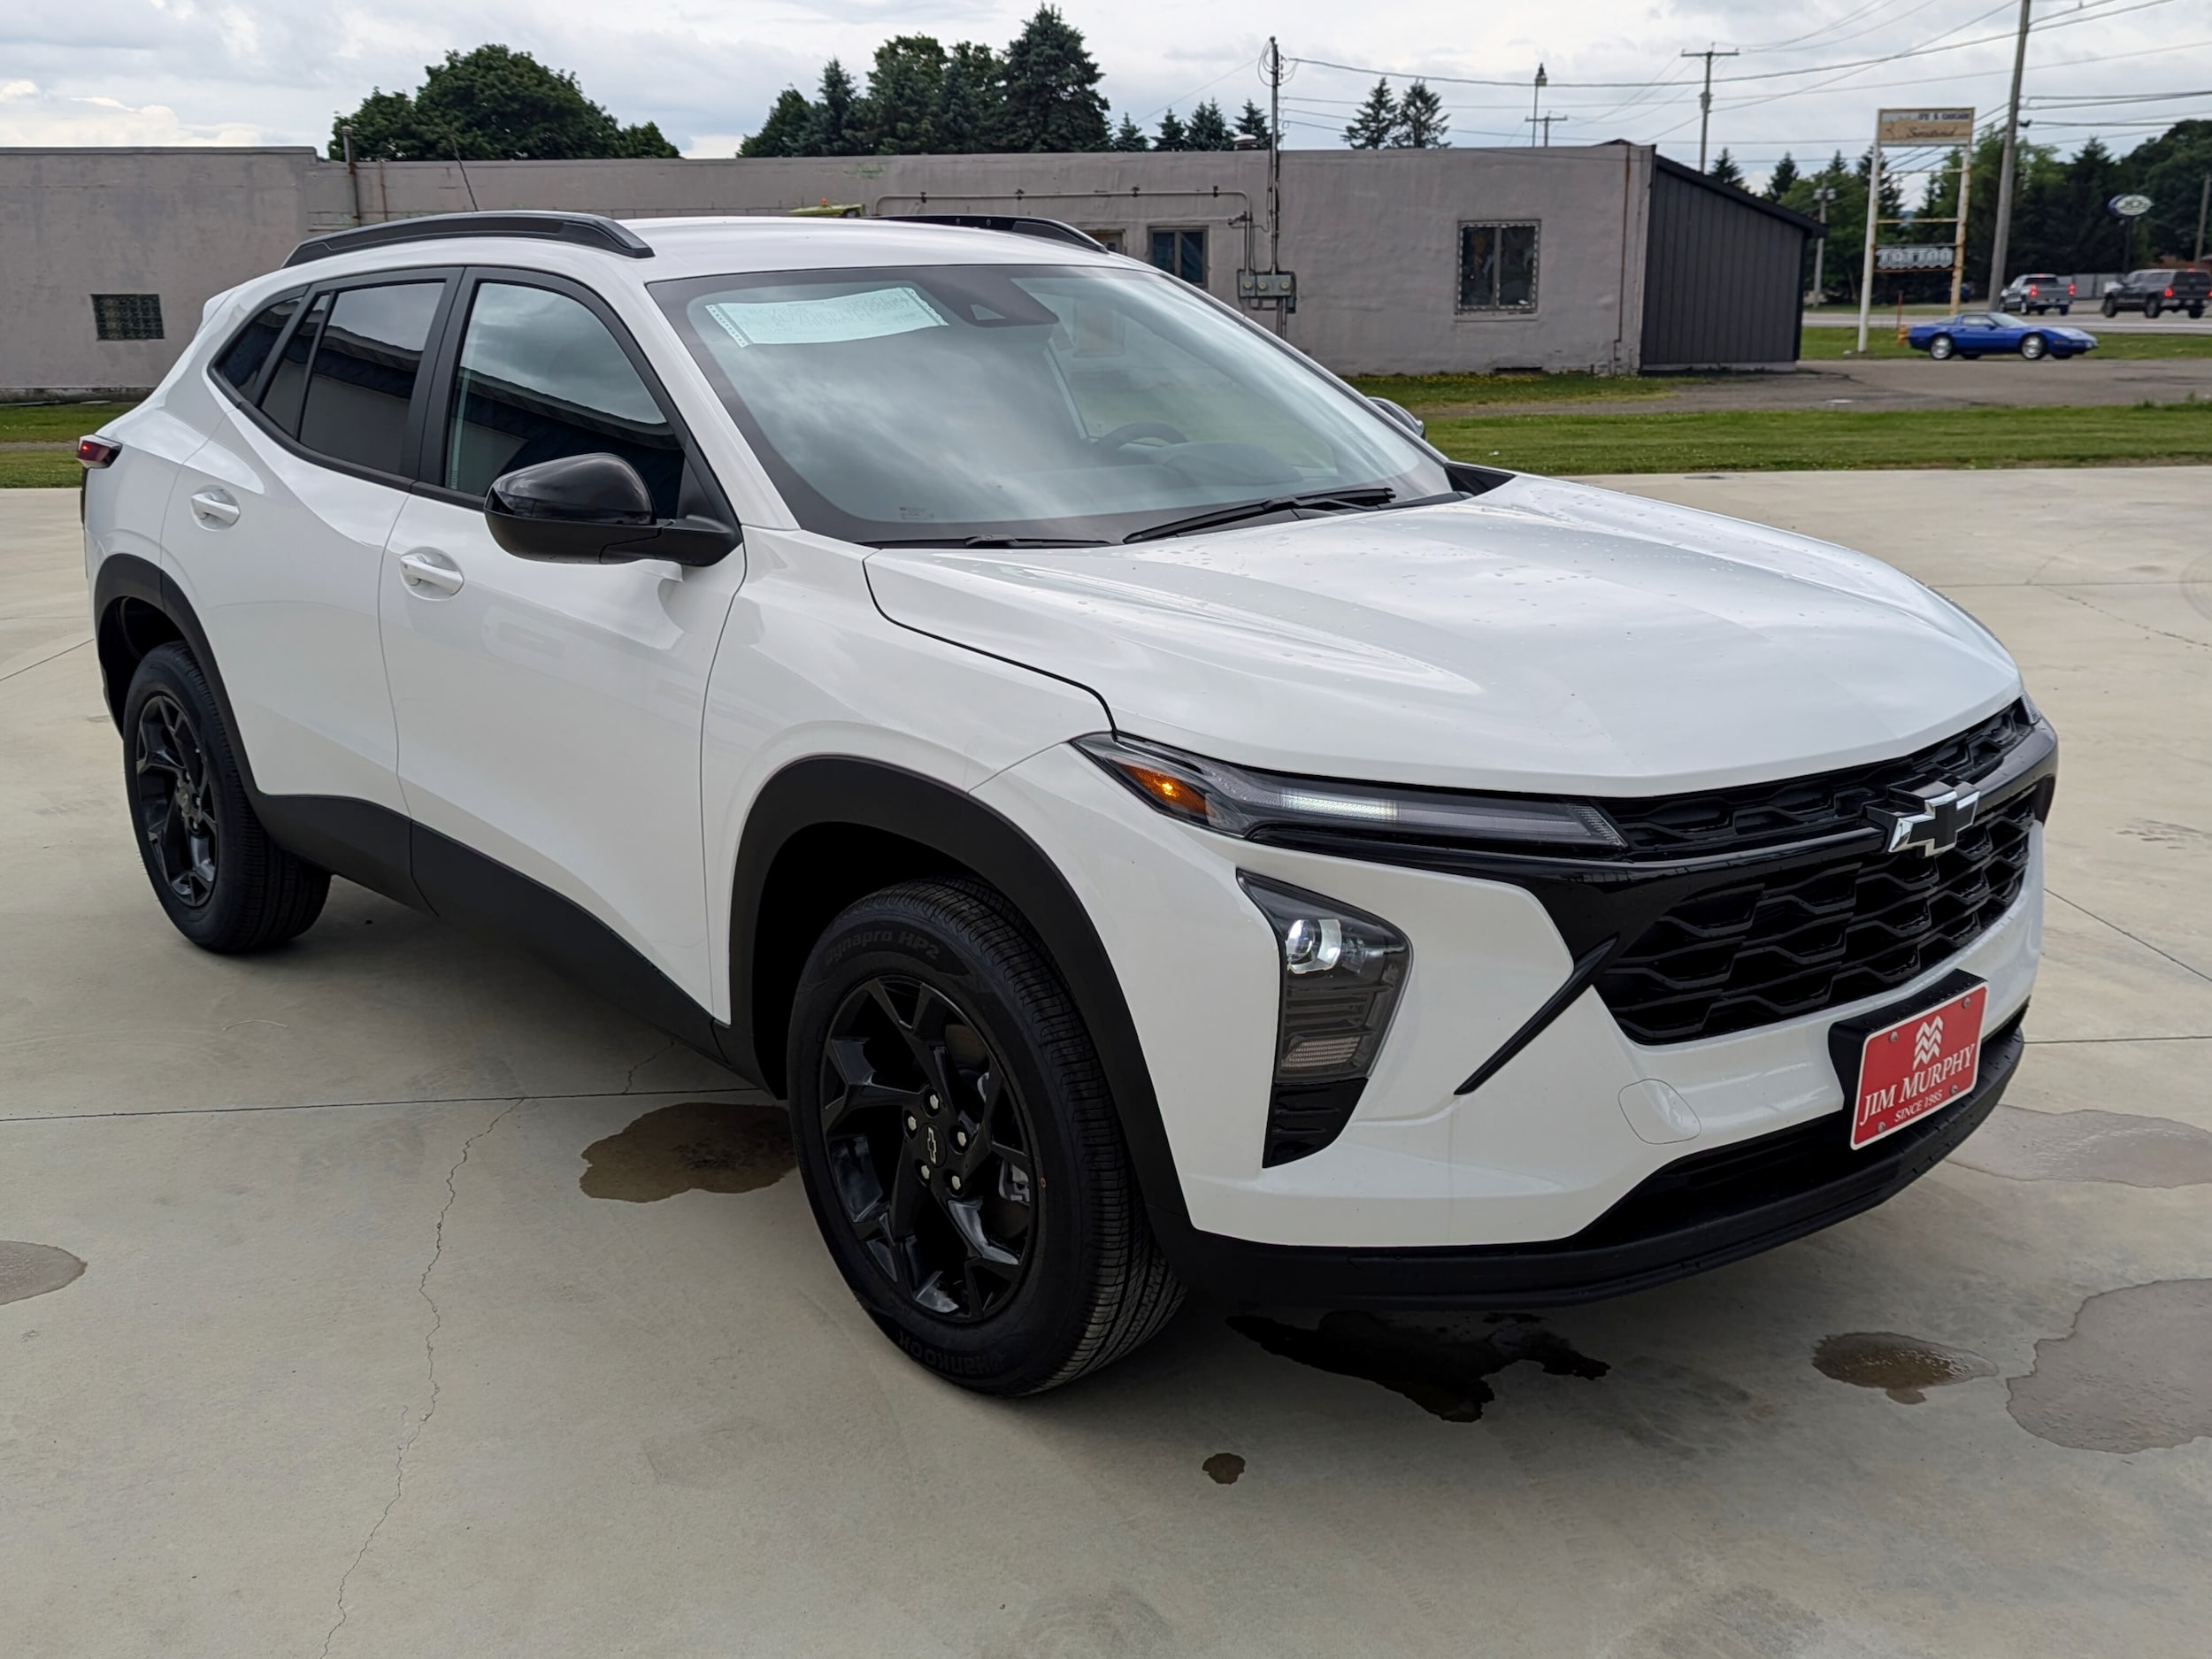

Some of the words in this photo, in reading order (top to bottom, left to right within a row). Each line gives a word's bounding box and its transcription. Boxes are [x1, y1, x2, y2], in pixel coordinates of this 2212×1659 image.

[825, 930, 893, 967] Dynapro
[898, 931, 940, 960] HP2
[1859, 1084, 1897, 1125] JIM
[1899, 1043, 1975, 1104] MURPHY
[1893, 1100, 1924, 1123] SINCE
